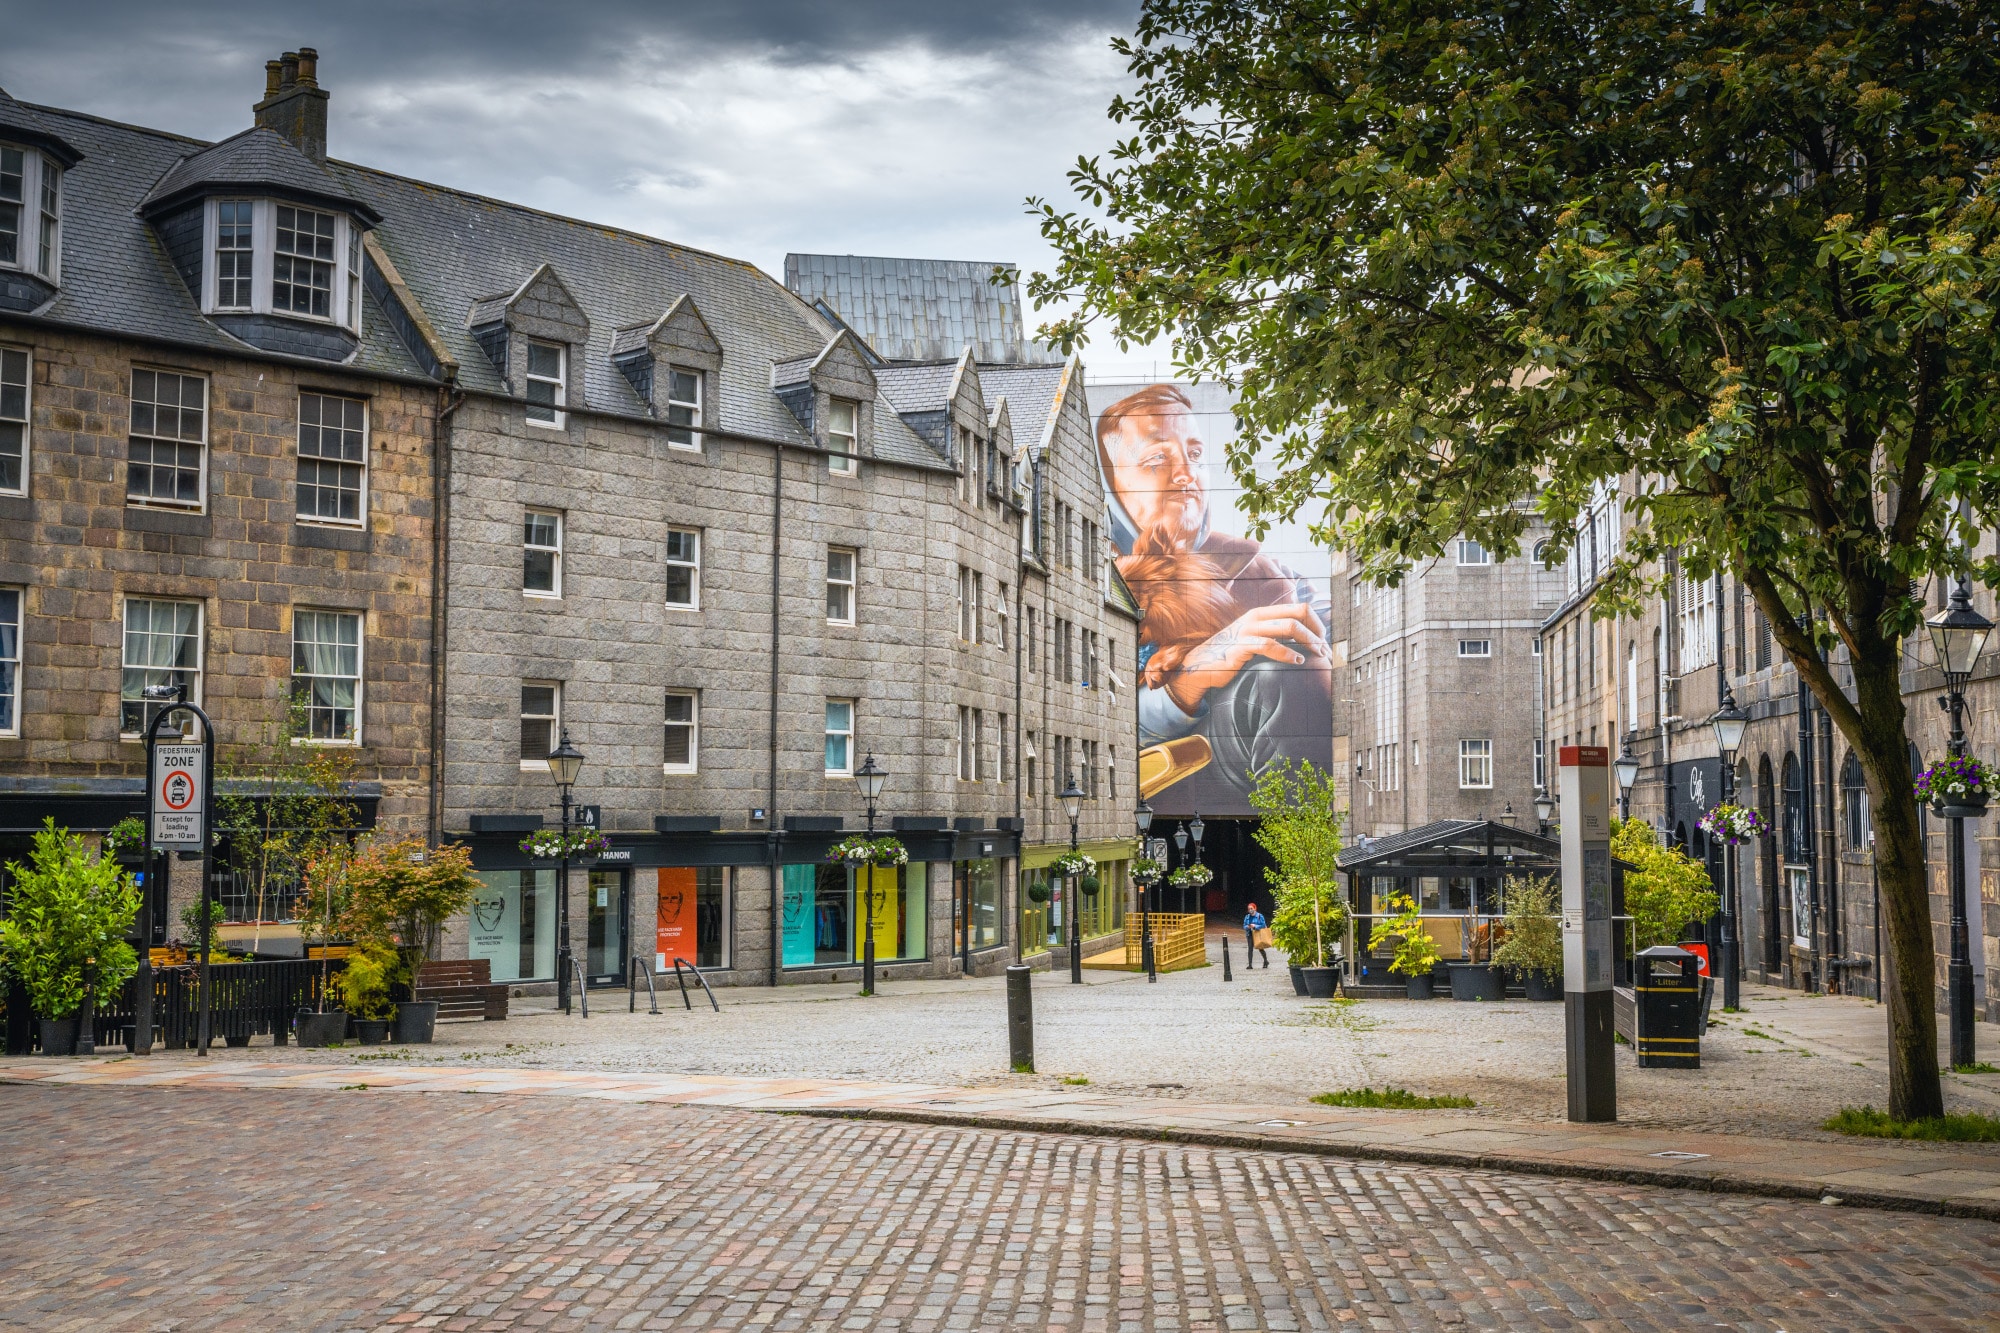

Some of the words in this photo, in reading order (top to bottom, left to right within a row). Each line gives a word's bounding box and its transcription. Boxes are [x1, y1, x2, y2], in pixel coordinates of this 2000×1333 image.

[164, 756, 194, 767] ZONE
[162, 815, 182, 824] Except
[184, 815, 194, 823] for
[166, 823, 189, 831] loading
[603, 851, 630, 859] HANON
[1657, 978, 1679, 986] Litter
